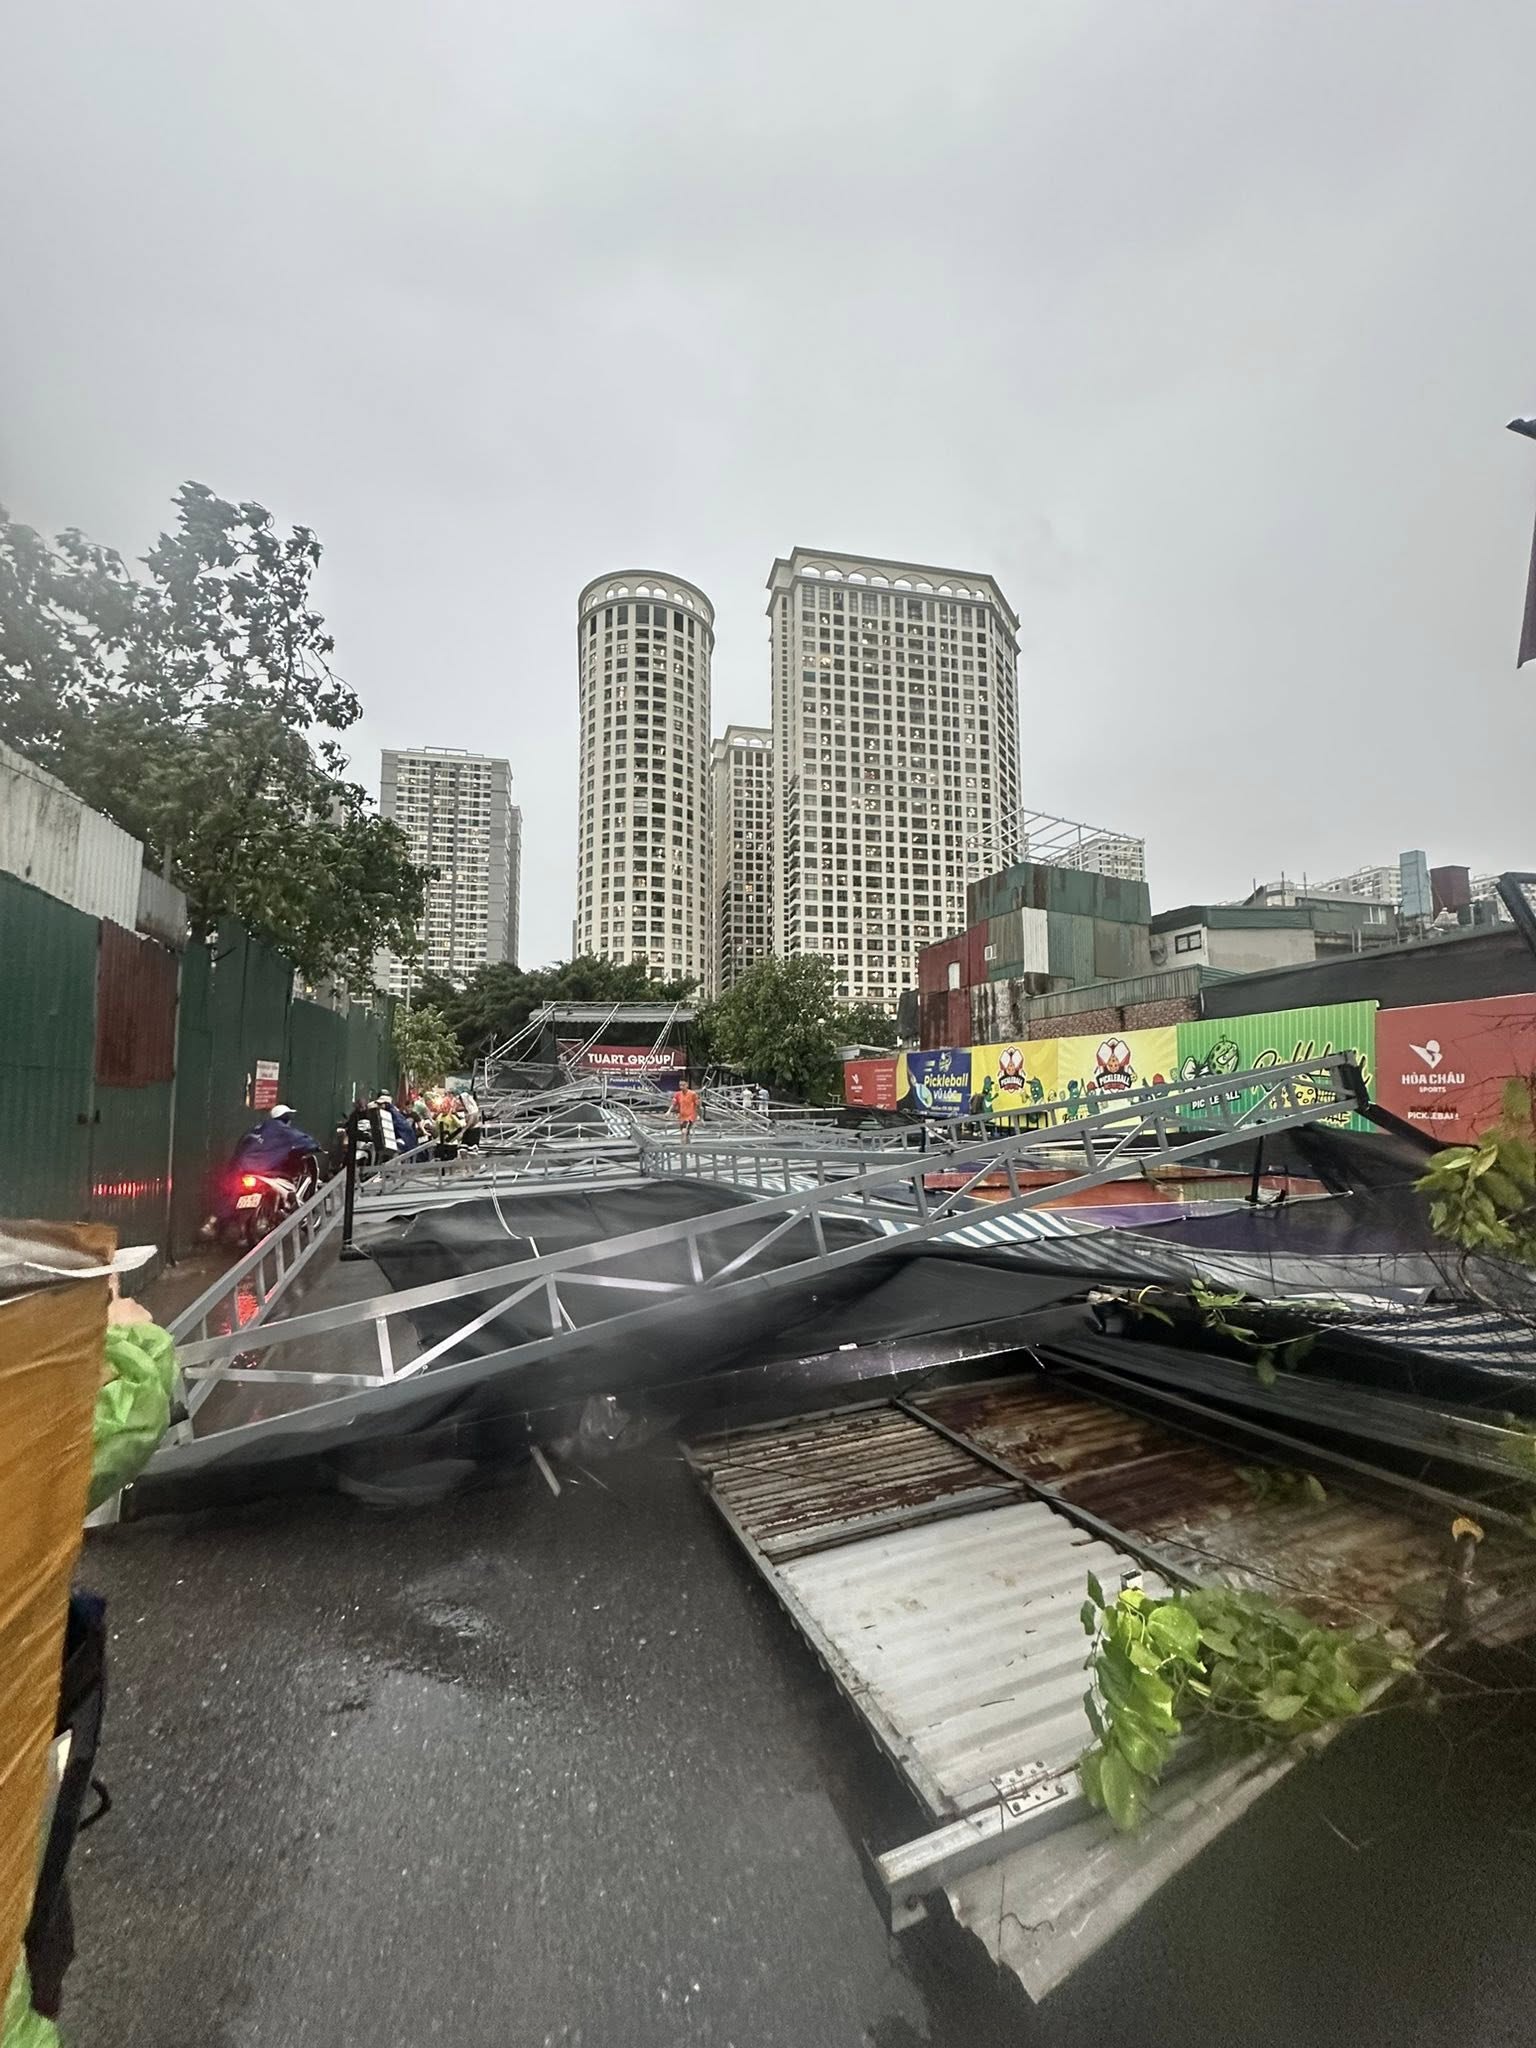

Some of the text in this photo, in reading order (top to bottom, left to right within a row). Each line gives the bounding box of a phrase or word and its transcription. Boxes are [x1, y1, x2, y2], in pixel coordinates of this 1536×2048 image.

[587, 1053, 671, 1065] TUART GROUP
[924, 1072, 969, 1088] Pickleball
